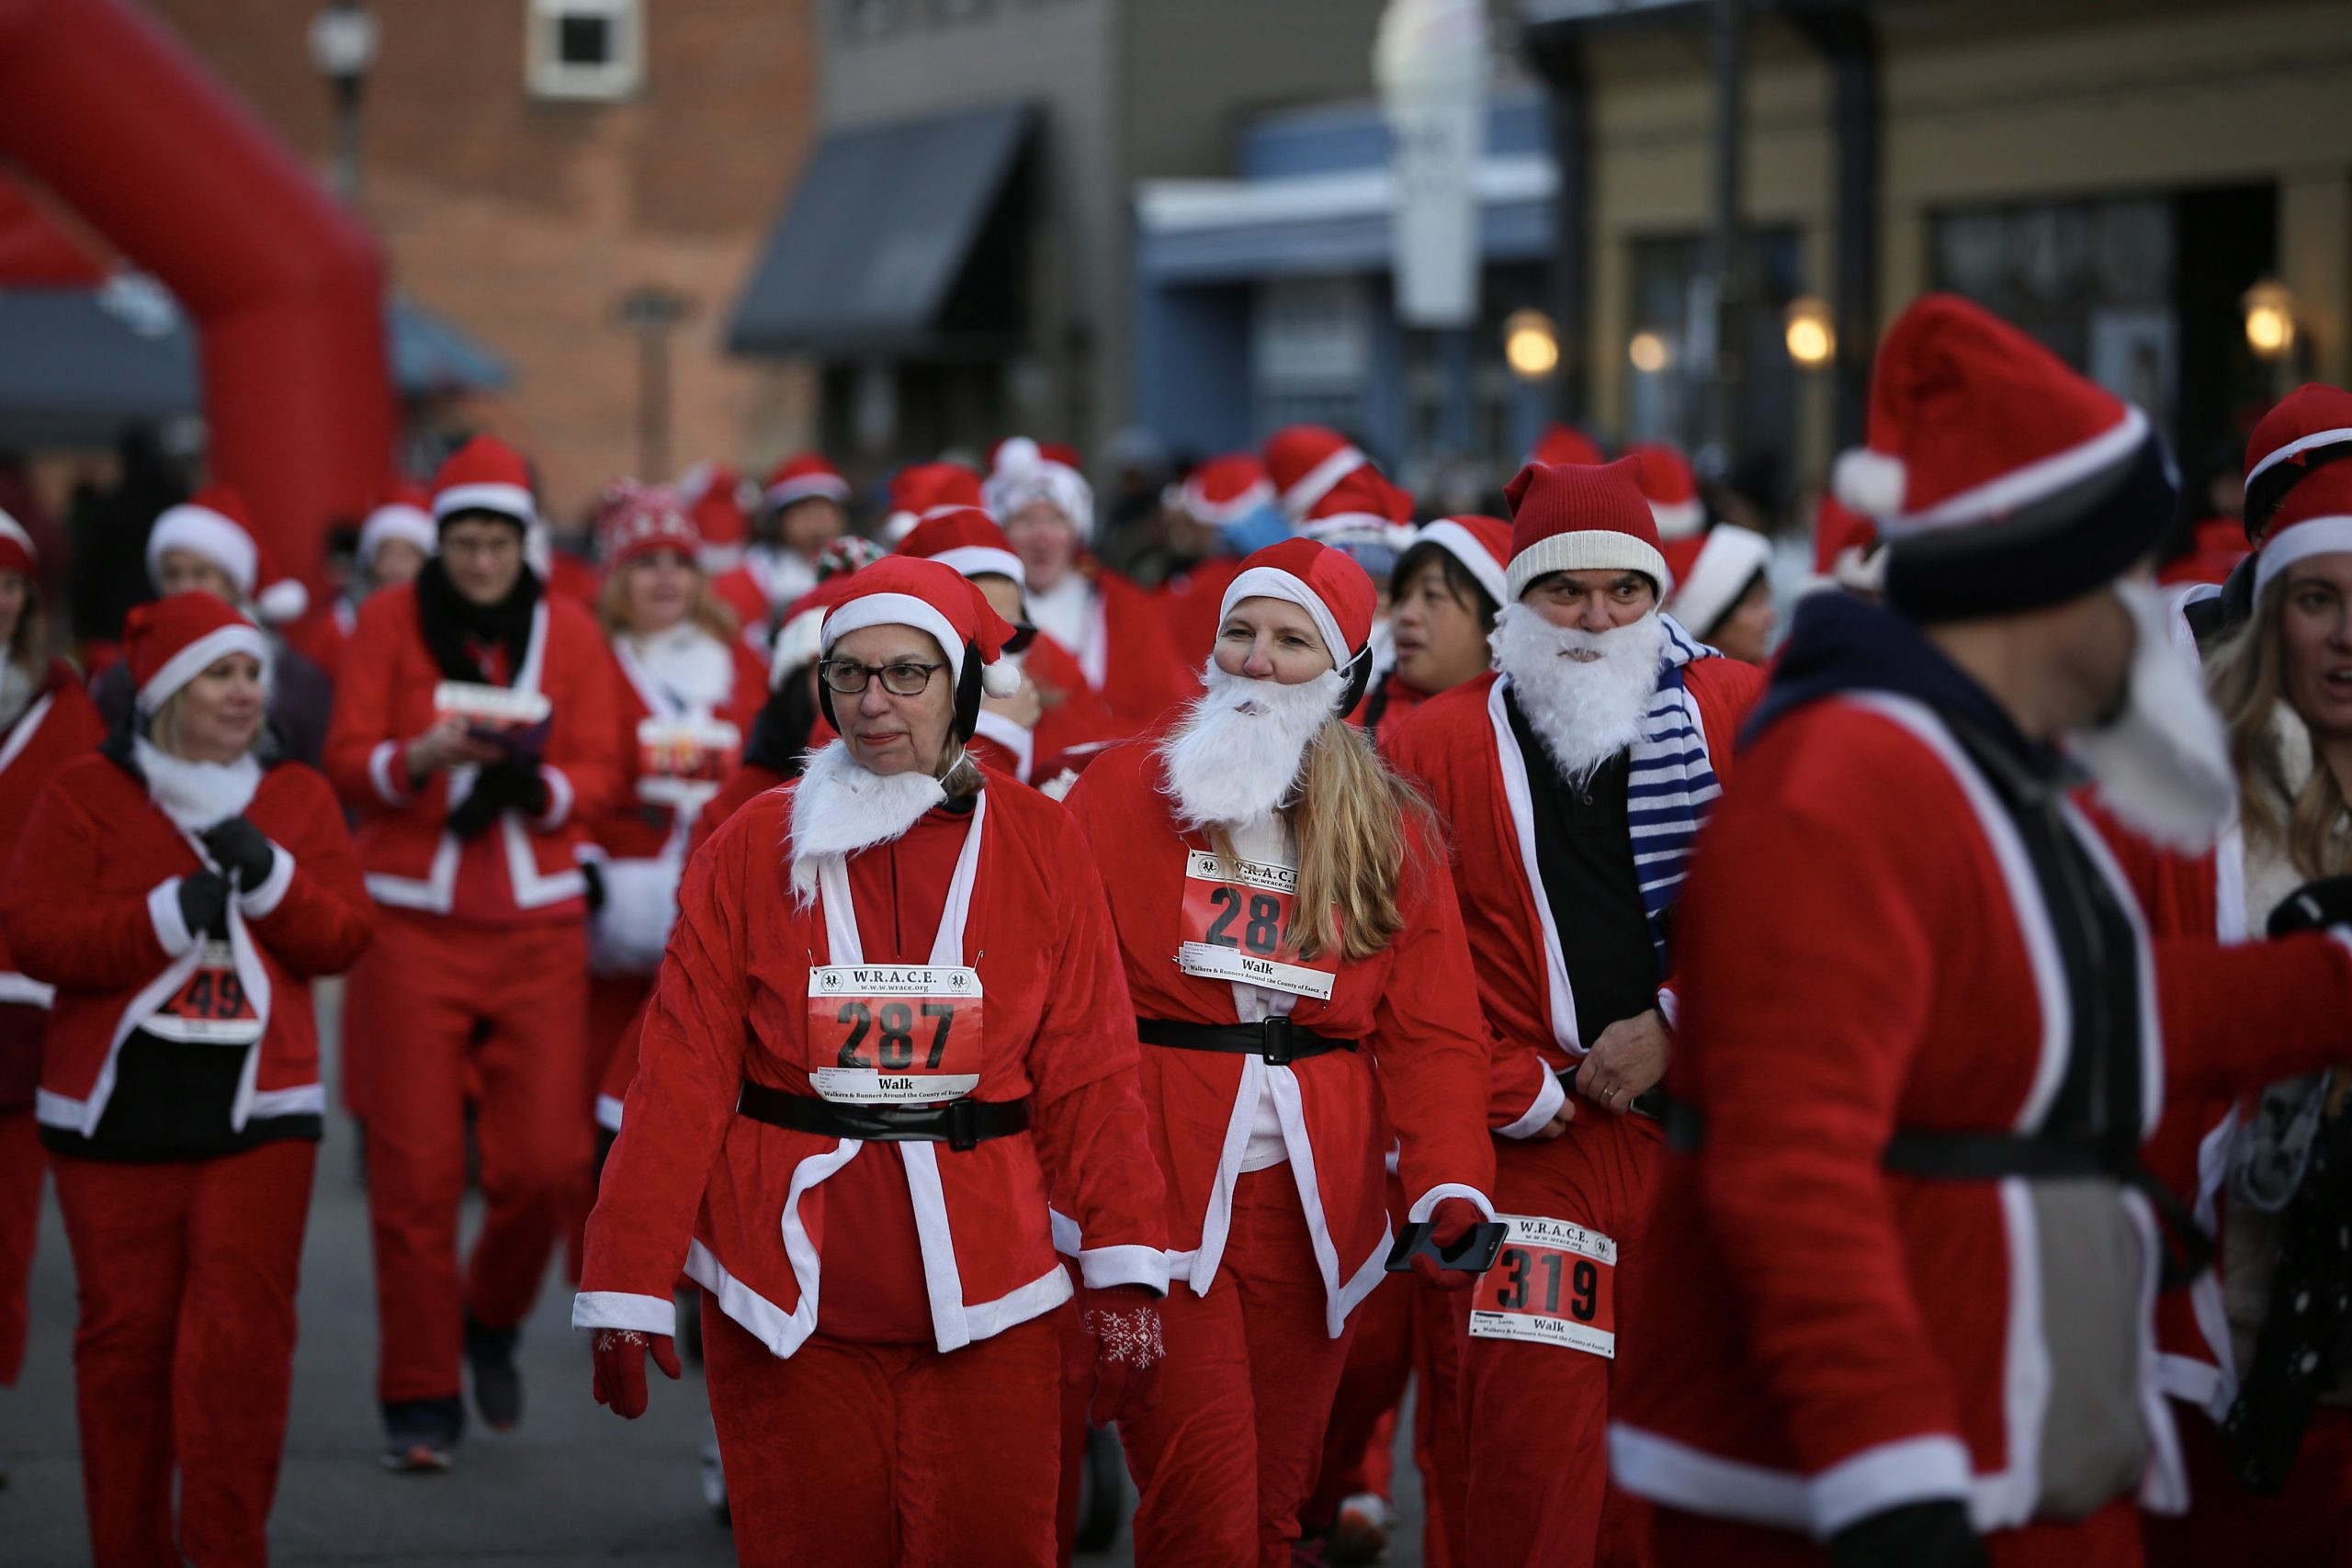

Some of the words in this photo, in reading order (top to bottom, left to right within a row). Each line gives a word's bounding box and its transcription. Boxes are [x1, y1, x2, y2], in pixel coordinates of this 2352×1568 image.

[1205, 886, 1311, 962] 28
[1242, 958, 1273, 976] Walk
[853, 970, 937, 984] W.R.A.C.E.
[1190, 964, 1212, 973] Walkers
[1219, 968, 1244, 977] Runners
[1245, 973, 1266, 982] Around
[1266, 976, 1276, 985] the
[1277, 979, 1297, 989] County
[1305, 985, 1319, 993] Essex
[860, 984, 929, 993] w.w.w.wrace.org
[837, 1001, 955, 1070] 287
[878, 1078, 913, 1089] Walk
[1520, 1221, 1589, 1244] W.R.A.C.E.
[1498, 1248, 1598, 1322] 319
[1533, 1318, 1565, 1333] Walk
[1558, 1334, 1567, 1342] the
